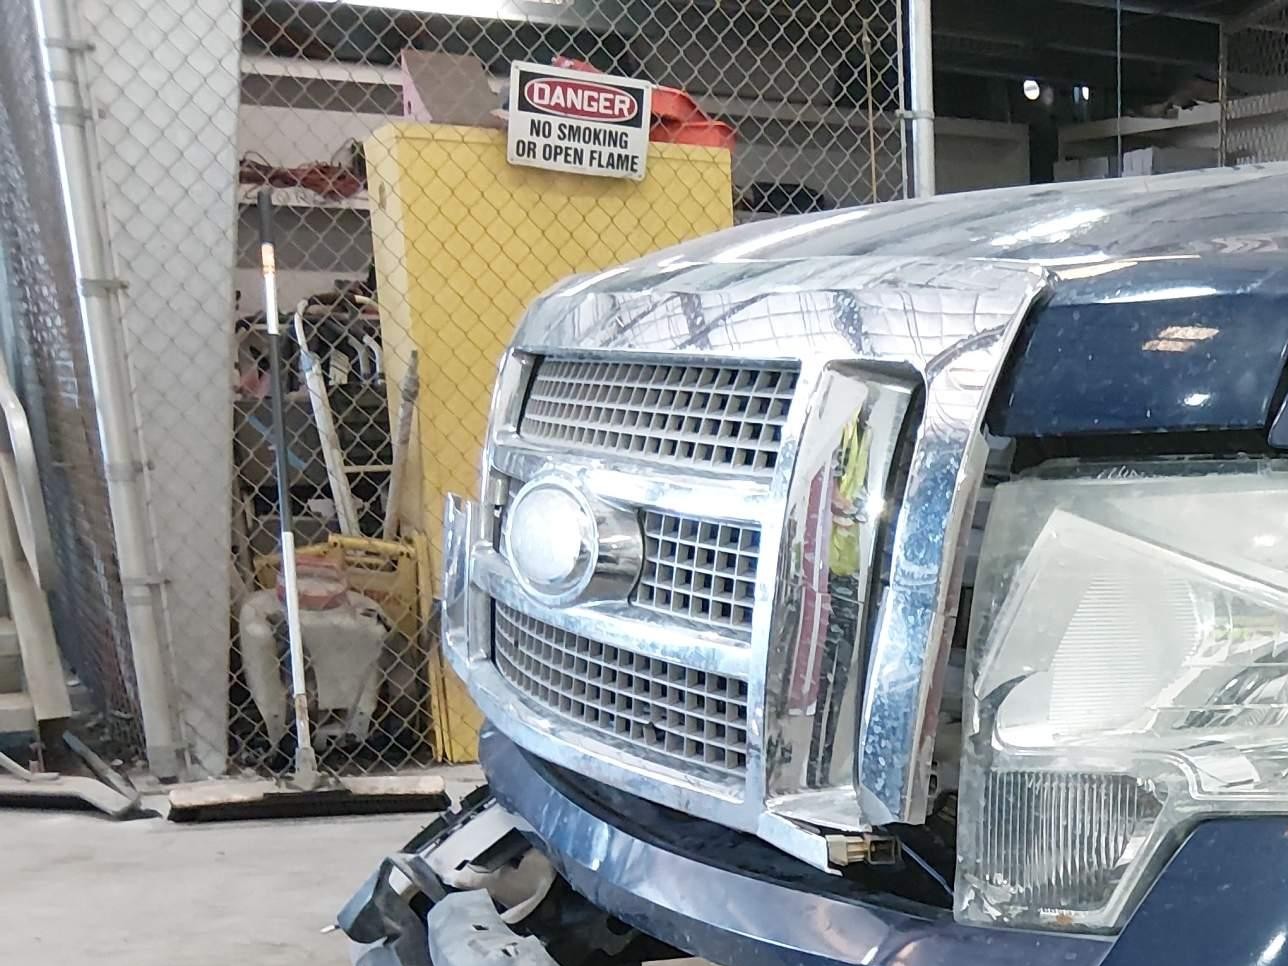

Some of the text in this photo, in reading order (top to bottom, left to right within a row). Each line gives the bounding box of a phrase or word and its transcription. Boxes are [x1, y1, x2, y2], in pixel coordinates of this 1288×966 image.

[533, 82, 630, 117] DANGER
[529, 118, 629, 149] NO SMOKING
[516, 139, 639, 173] OR OPEN FLAME
